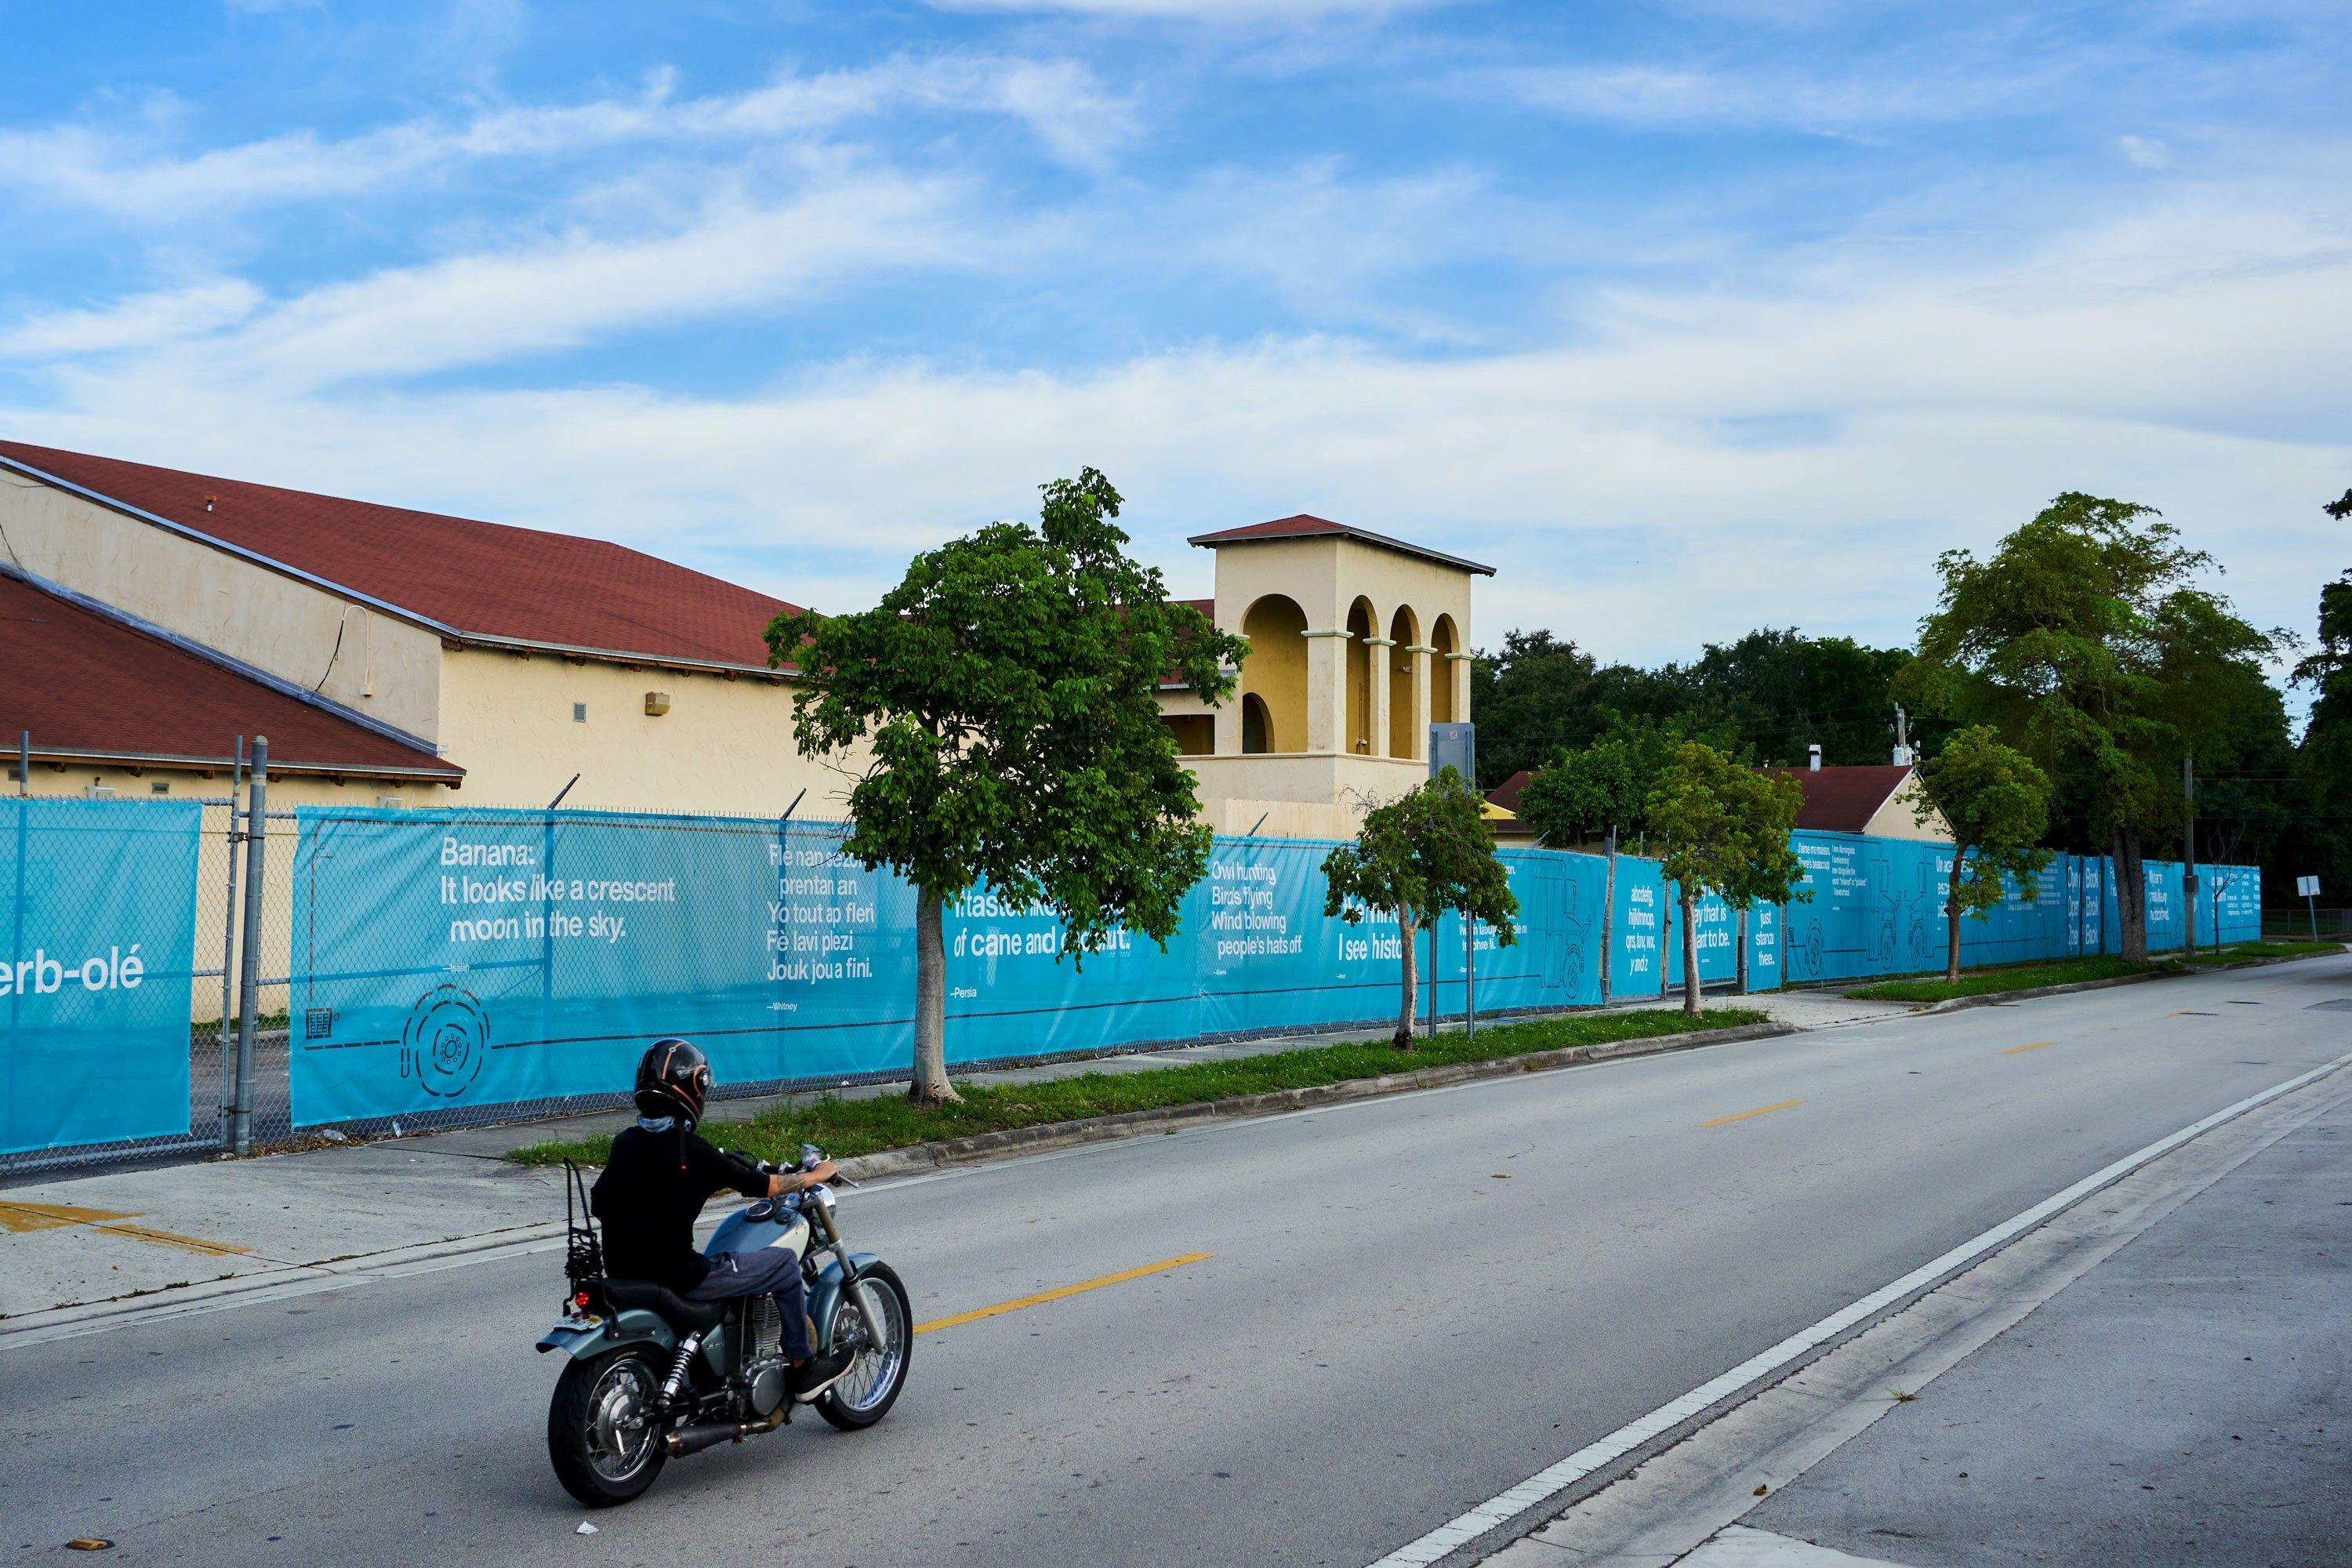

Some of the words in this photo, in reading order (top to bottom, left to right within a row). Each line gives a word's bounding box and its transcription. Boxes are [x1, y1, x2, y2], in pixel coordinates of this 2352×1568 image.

[441, 837, 535, 866] Banana:
[795, 850, 823, 867] nan
[1212, 860, 1234, 880] Owl
[1236, 862, 1276, 885] hunting
[2085, 867, 2099, 889] Book
[441, 875, 457, 904] It
[463, 875, 526, 904] looks
[530, 873, 565, 901] like
[570, 880, 583, 901] a
[588, 877, 675, 902] crescent
[779, 876, 834, 900] prentan
[837, 879, 857, 895] an
[1212, 885, 1242, 905] Birds
[1243, 886, 1272, 909] flying
[767, 902, 789, 924] Yo
[793, 903, 823, 924] tout
[826, 907, 842, 927] ap
[846, 902, 875, 923] fleri
[1704, 903, 1719, 922] that
[1720, 903, 1726, 921] is
[2085, 895, 2099, 916] Book
[451, 918, 519, 942] moon
[524, 911, 545, 938] in
[549, 911, 583, 937] the
[589, 910, 626, 943] sky.
[1212, 911, 1242, 930] Wind
[1244, 912, 1286, 934] blowing
[1760, 910, 1772, 928] just
[767, 930, 789, 952] Fè
[793, 931, 818, 952] lavi
[822, 930, 853, 956] plezi
[954, 927, 967, 957] of
[971, 931, 1022, 956] cane
[1026, 926, 1055, 955] and
[1267, 936, 1287, 954] hats
[1339, 933, 1343, 961] I
[1345, 939, 1368, 961] see
[1372, 932, 1403, 960] histo
[1708, 930, 1717, 947] to
[1719, 928, 1730, 946] be.
[2085, 924, 2098, 945] Book
[767, 959, 808, 981] Jouk
[811, 960, 833, 985] jou
[835, 964, 843, 978] a
[846, 957, 873, 978] fini.
[1635, 954, 1645, 972] and
